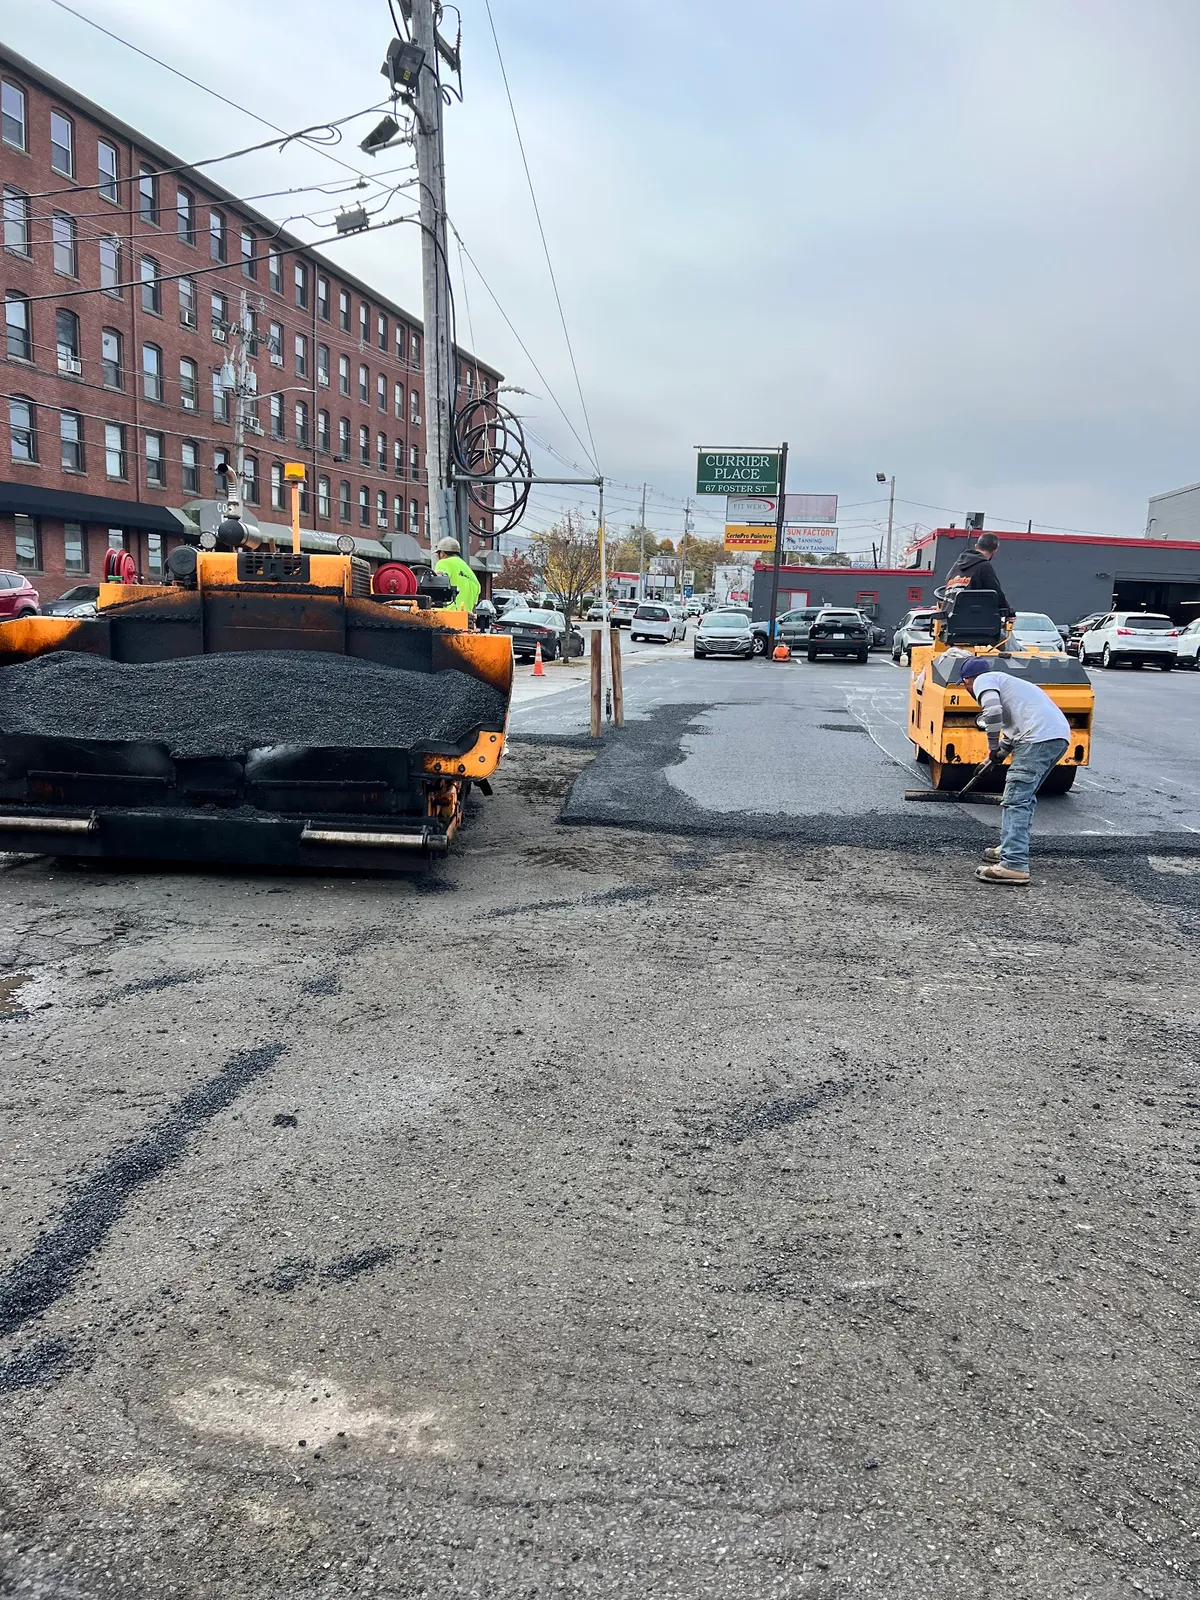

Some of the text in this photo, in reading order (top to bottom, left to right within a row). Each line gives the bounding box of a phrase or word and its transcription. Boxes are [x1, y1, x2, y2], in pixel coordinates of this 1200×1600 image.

[706, 455, 770, 467] CURRIER
[714, 468, 760, 480] PLACE
[705, 484, 767, 493] 67 FOSTER ST
[787, 528, 835, 537] SUN FACTORY
[950, 695, 960, 705] R1
